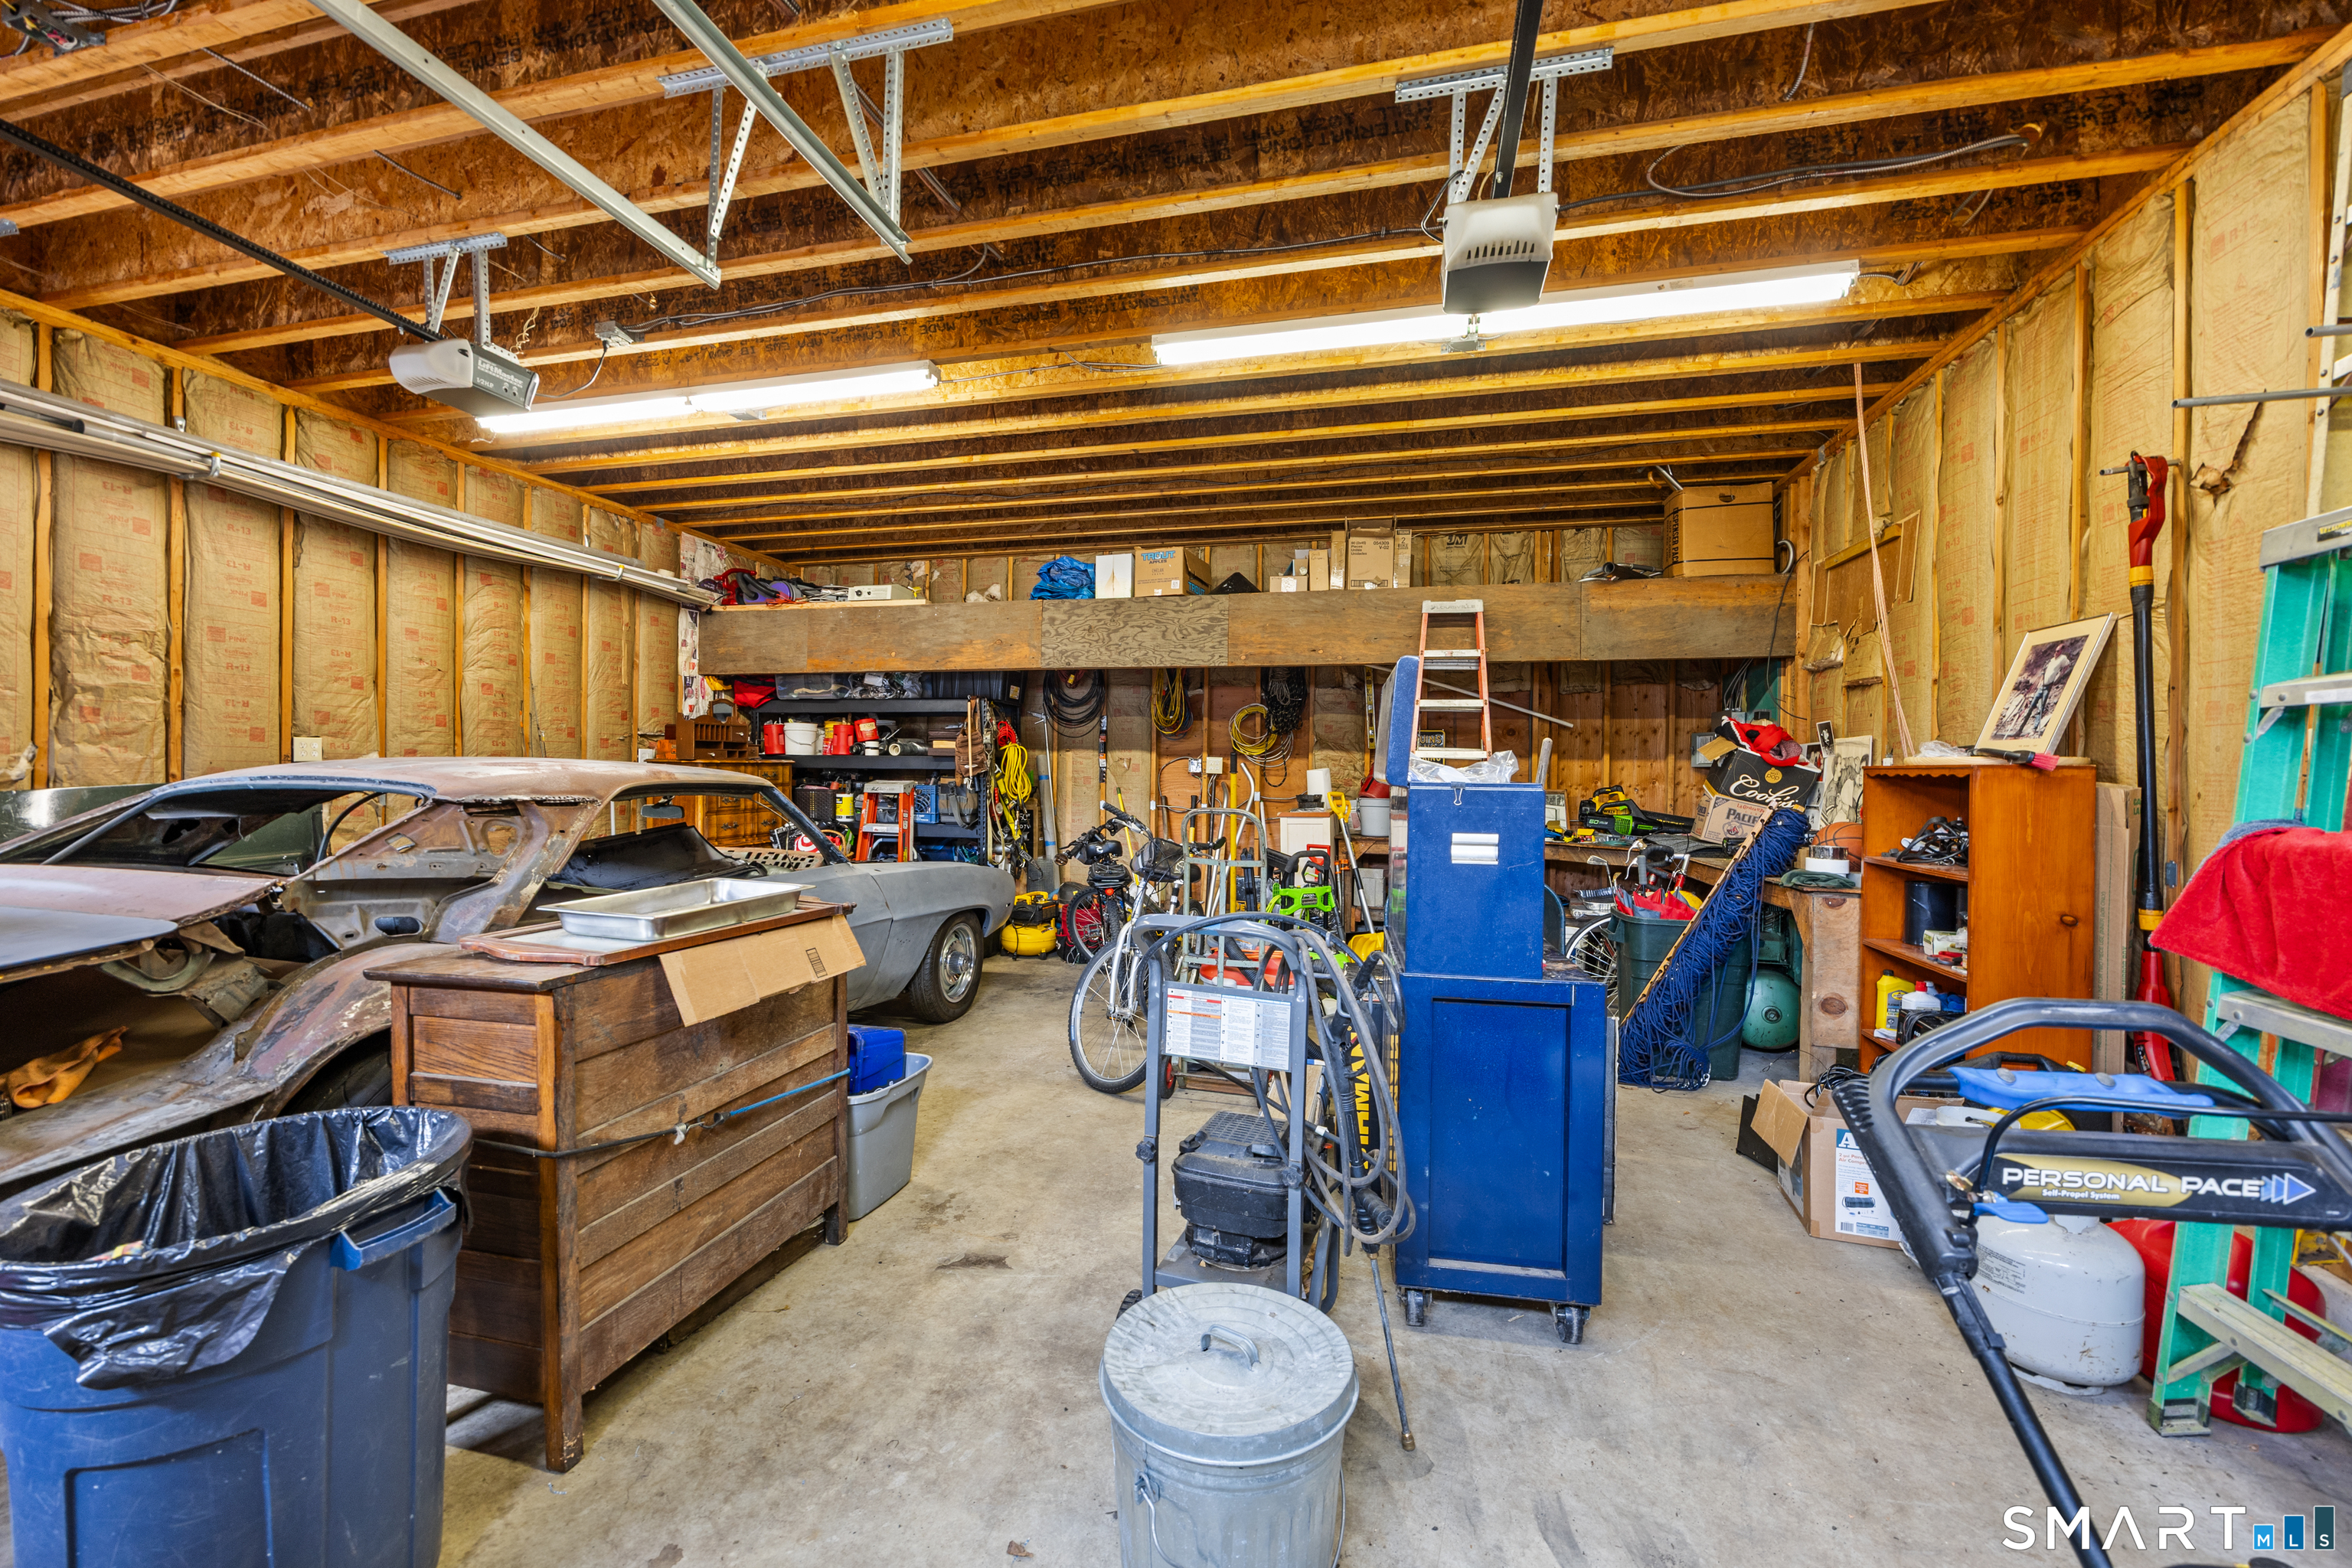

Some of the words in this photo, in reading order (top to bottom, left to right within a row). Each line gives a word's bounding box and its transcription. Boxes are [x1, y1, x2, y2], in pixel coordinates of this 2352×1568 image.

[1243, 116, 1432, 156] INTERNATIONAL
[1011, 308, 1060, 325] BEAMS
[478, 359, 524, 384] LiftMaster
[229, 421, 253, 435] R-13
[2030, 428, 2050, 446] R-13
[102, 481, 132, 495] R-13
[492, 493, 508, 503] R-13
[227, 524, 252, 535] R-13
[1448, 534, 1467, 545] JM
[1945, 536, 1961, 550] R-13
[1141, 550, 1176, 561] TROUT
[225, 559, 251, 571] R-13
[419, 570, 436, 580] R-13
[1187, 581, 1205, 595] TROUT
[102, 594, 132, 606] R-13
[331, 616, 351, 626] R-13
[228, 635, 247, 644] PINK
[330, 650, 351, 658] R-13
[226, 662, 250, 671] R-13
[224, 698, 250, 707] R-13
[1726, 807, 1759, 825] PACIF
[2001, 1166, 2168, 1194] PERSONAL
[2180, 1176, 2265, 1198] PACE
[2042, 1188, 2088, 1200] Self-Propel
[2089, 1190, 2121, 1201] System
